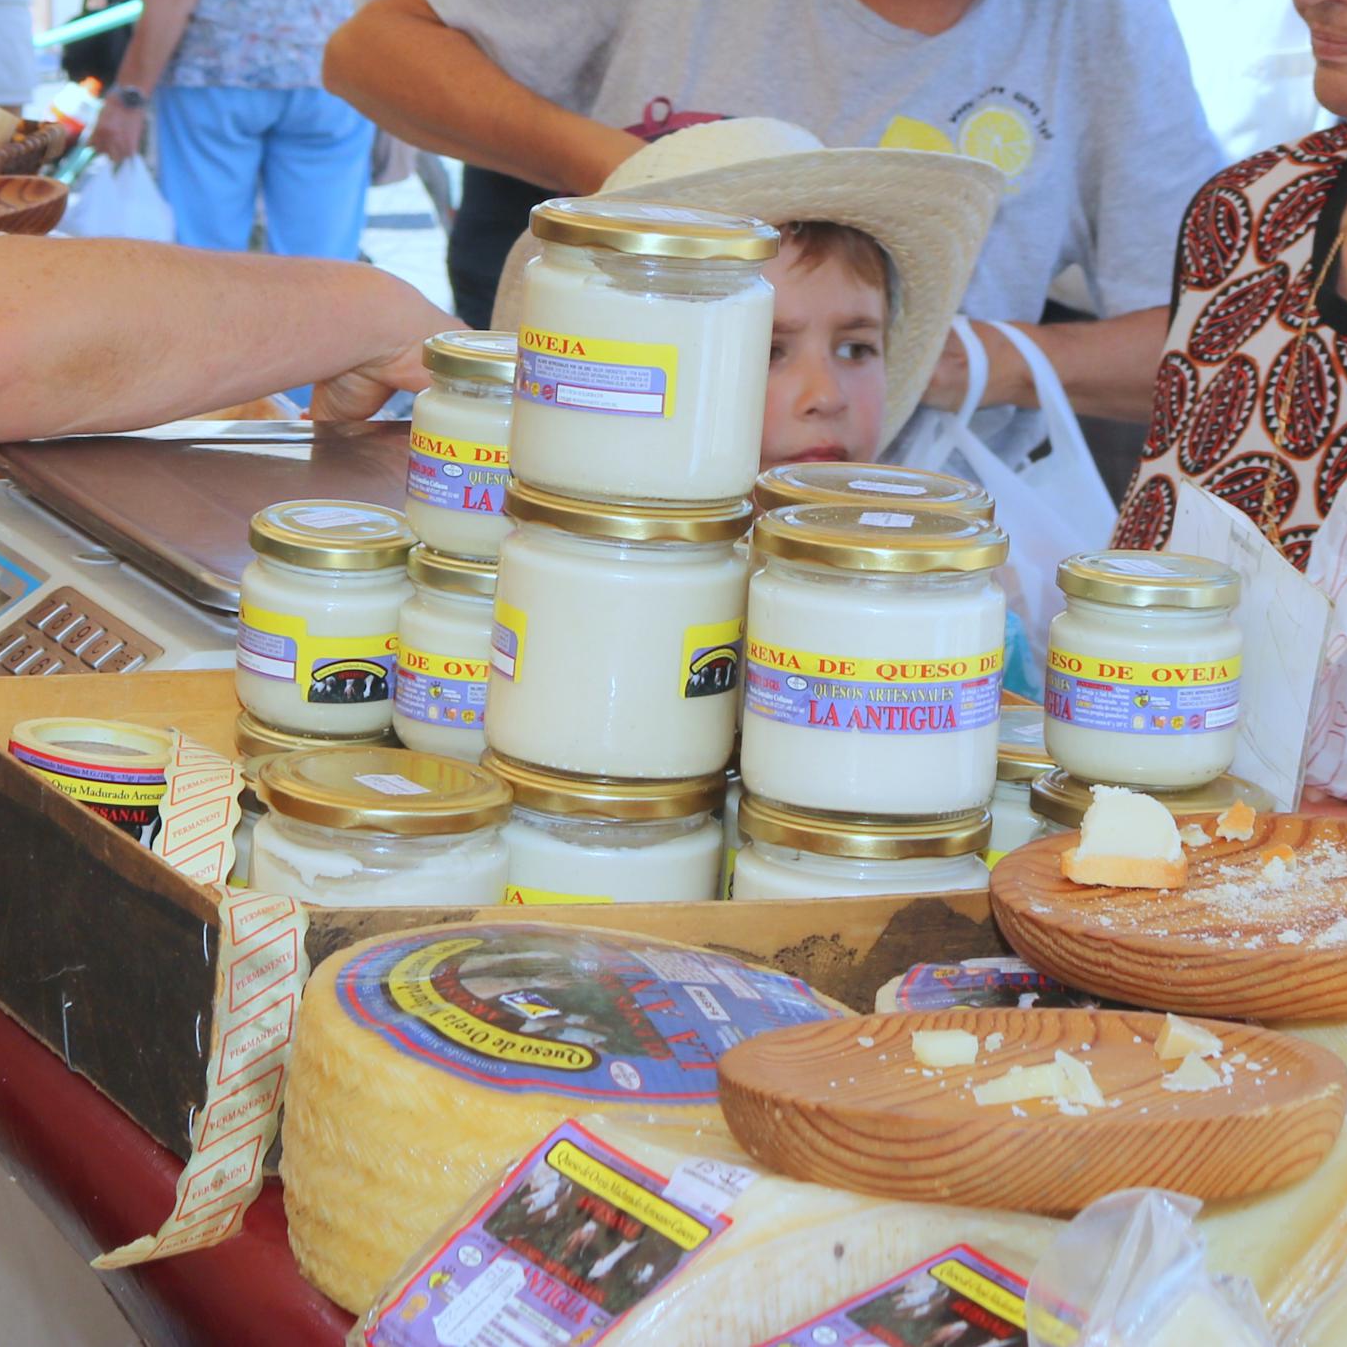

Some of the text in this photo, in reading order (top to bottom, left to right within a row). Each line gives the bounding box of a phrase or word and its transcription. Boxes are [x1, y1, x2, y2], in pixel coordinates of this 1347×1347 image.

[524, 331, 587, 356] OVEJA
[463, 486, 493, 512] LA
[51, 612, 73, 630] 8
[69, 626, 92, 644] 9
[10, 644, 33, 663] 5
[407, 653, 430, 670] DE
[818, 659, 856, 676] DE
[876, 662, 968, 681] QUESO
[979, 653, 998, 672] DE
[1098, 663, 1133, 680] DE
[1151, 665, 1229, 682] OVEJA
[812, 682, 955, 703] QUESOS ARTESANALES
[807, 699, 841, 727] LA
[846, 703, 958, 731] ANTIGUA
[52, 779, 77, 796] Oveja
[80, 785, 131, 801] Madurado
[172, 810, 221, 839] PERMANENT
[235, 951, 293, 990] PERMANENTE
[443, 1009, 490, 1044] Oveja
[492, 1038, 516, 1054] de
[520, 1043, 585, 1066] Queso
[209, 1090, 273, 1131] PERMANENTE
[192, 1163, 248, 1201] PERMANENT
